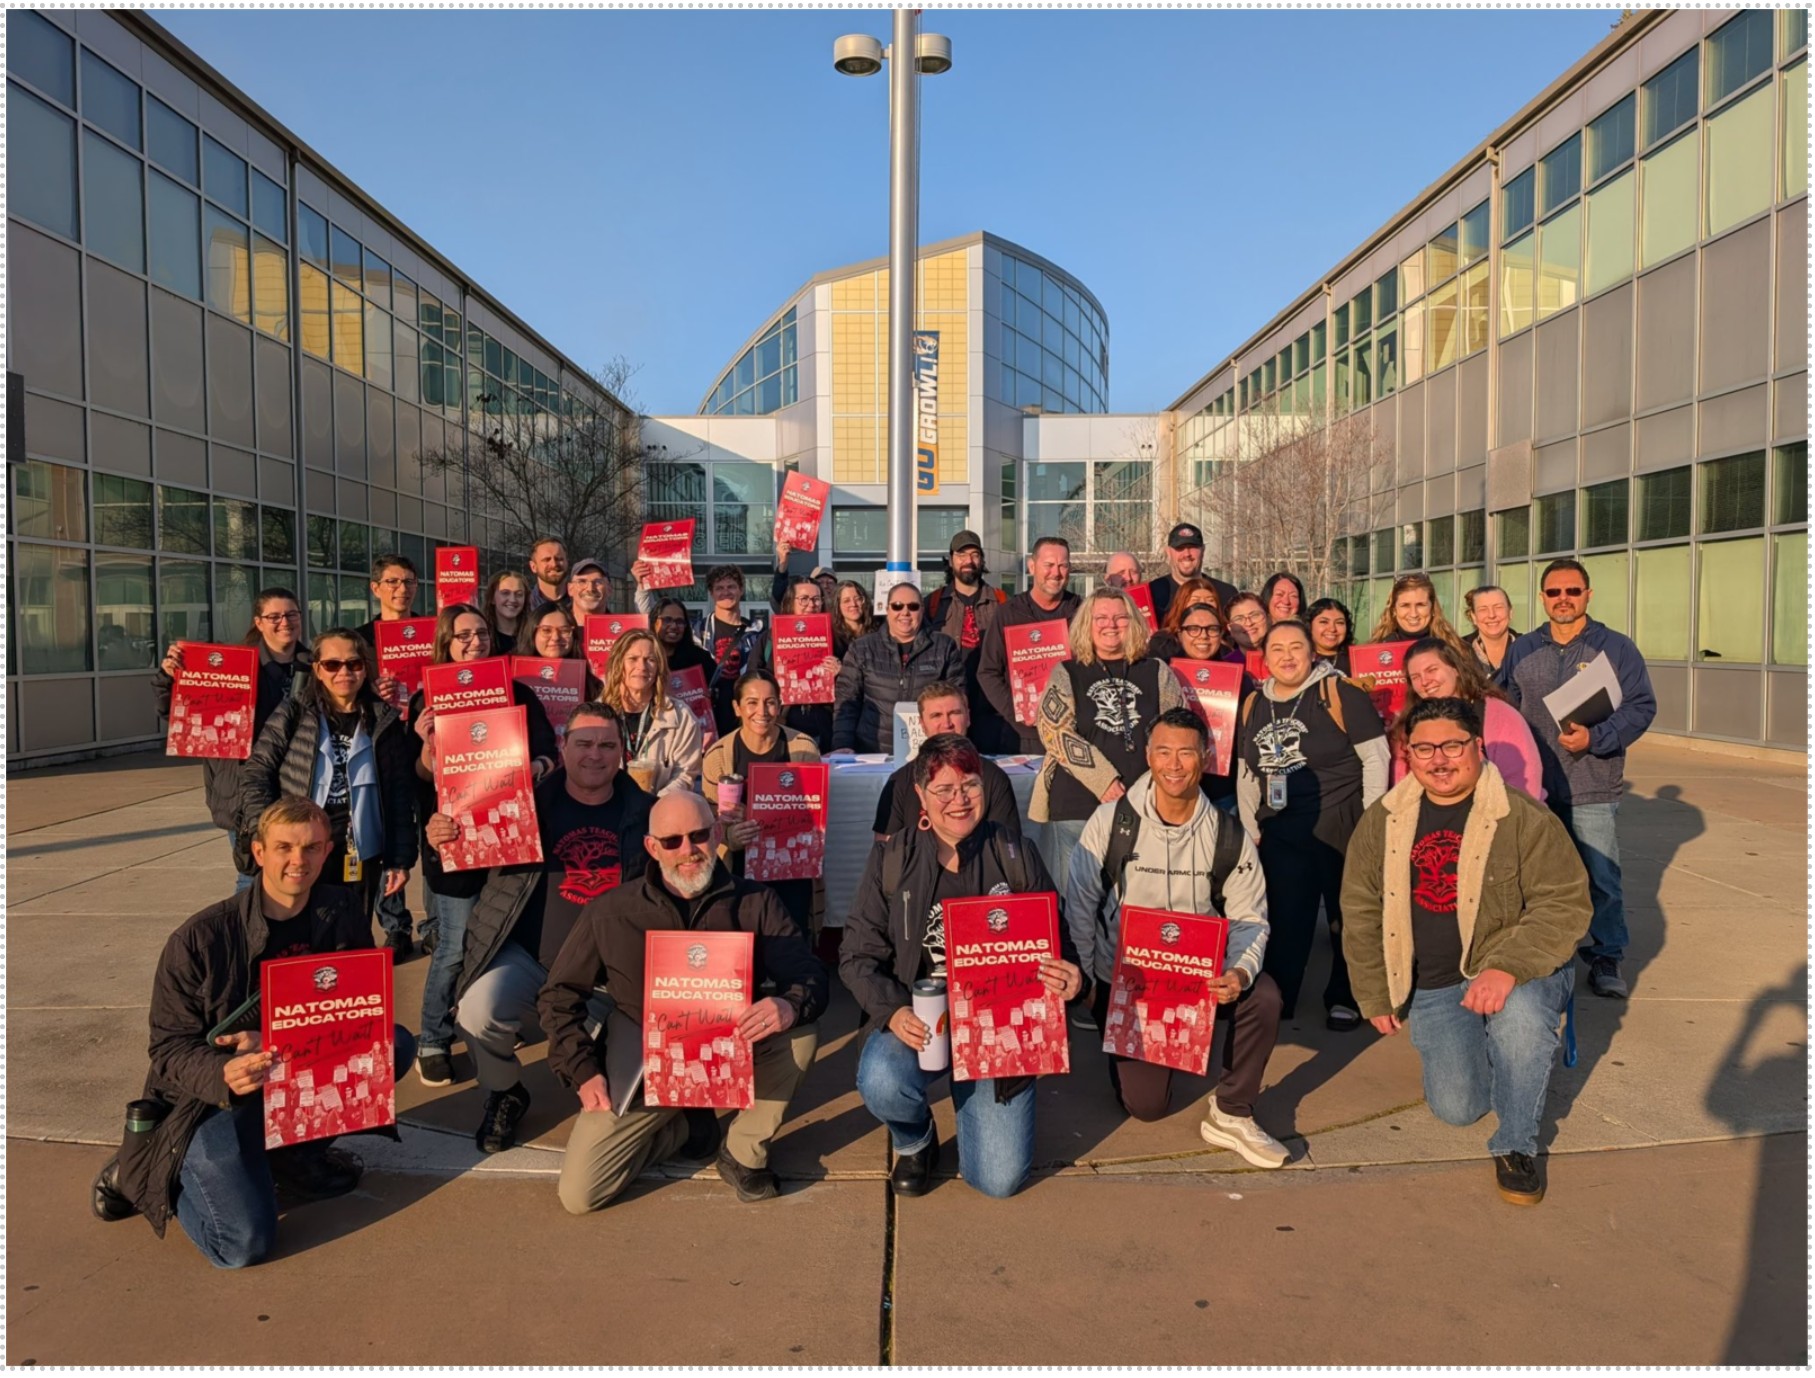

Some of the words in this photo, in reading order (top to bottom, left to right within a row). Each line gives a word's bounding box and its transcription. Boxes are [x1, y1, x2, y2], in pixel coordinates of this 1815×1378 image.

[919, 357, 938, 444] GROWL!
[917, 447, 935, 490] GO
[383, 642, 433, 653] NATOMA
[1012, 643, 1065, 656] NATOMAS
[1012, 650, 1066, 663] EDUCATORS
[179, 679, 251, 690] EDUCATORS
[182, 671, 250, 682] NATOMAS
[433, 687, 505, 703] NATOMAS
[1181, 686, 1232, 698] ATOMAS
[431, 696, 508, 711] EDUCATORS
[444, 745, 523, 765] NATOMAS
[443, 758, 523, 775] EDUCATORS
[752, 802, 822, 811] EDUCATORS
[755, 794, 820, 803] NATOMAS
[1134, 866, 1166, 875] UNDER
[955, 939, 1049, 956] NATOMAS
[953, 952, 1052, 968] EDUCATORS
[1125, 946, 1213, 968] NATOMAS
[1122, 956, 1213, 979] EDUCATORS
[655, 977, 743, 990] NATOMAS
[963, 975, 999, 1001] Can't
[651, 989, 744, 1001] EDUCATORS
[274, 994, 382, 1018] NATOMAS
[271, 1006, 384, 1031] EDUCATORS
[657, 1009, 692, 1032] Can't
[698, 1007, 734, 1025] Wait
[281, 1035, 324, 1063] Can't
[326, 1020, 375, 1046] Wait
